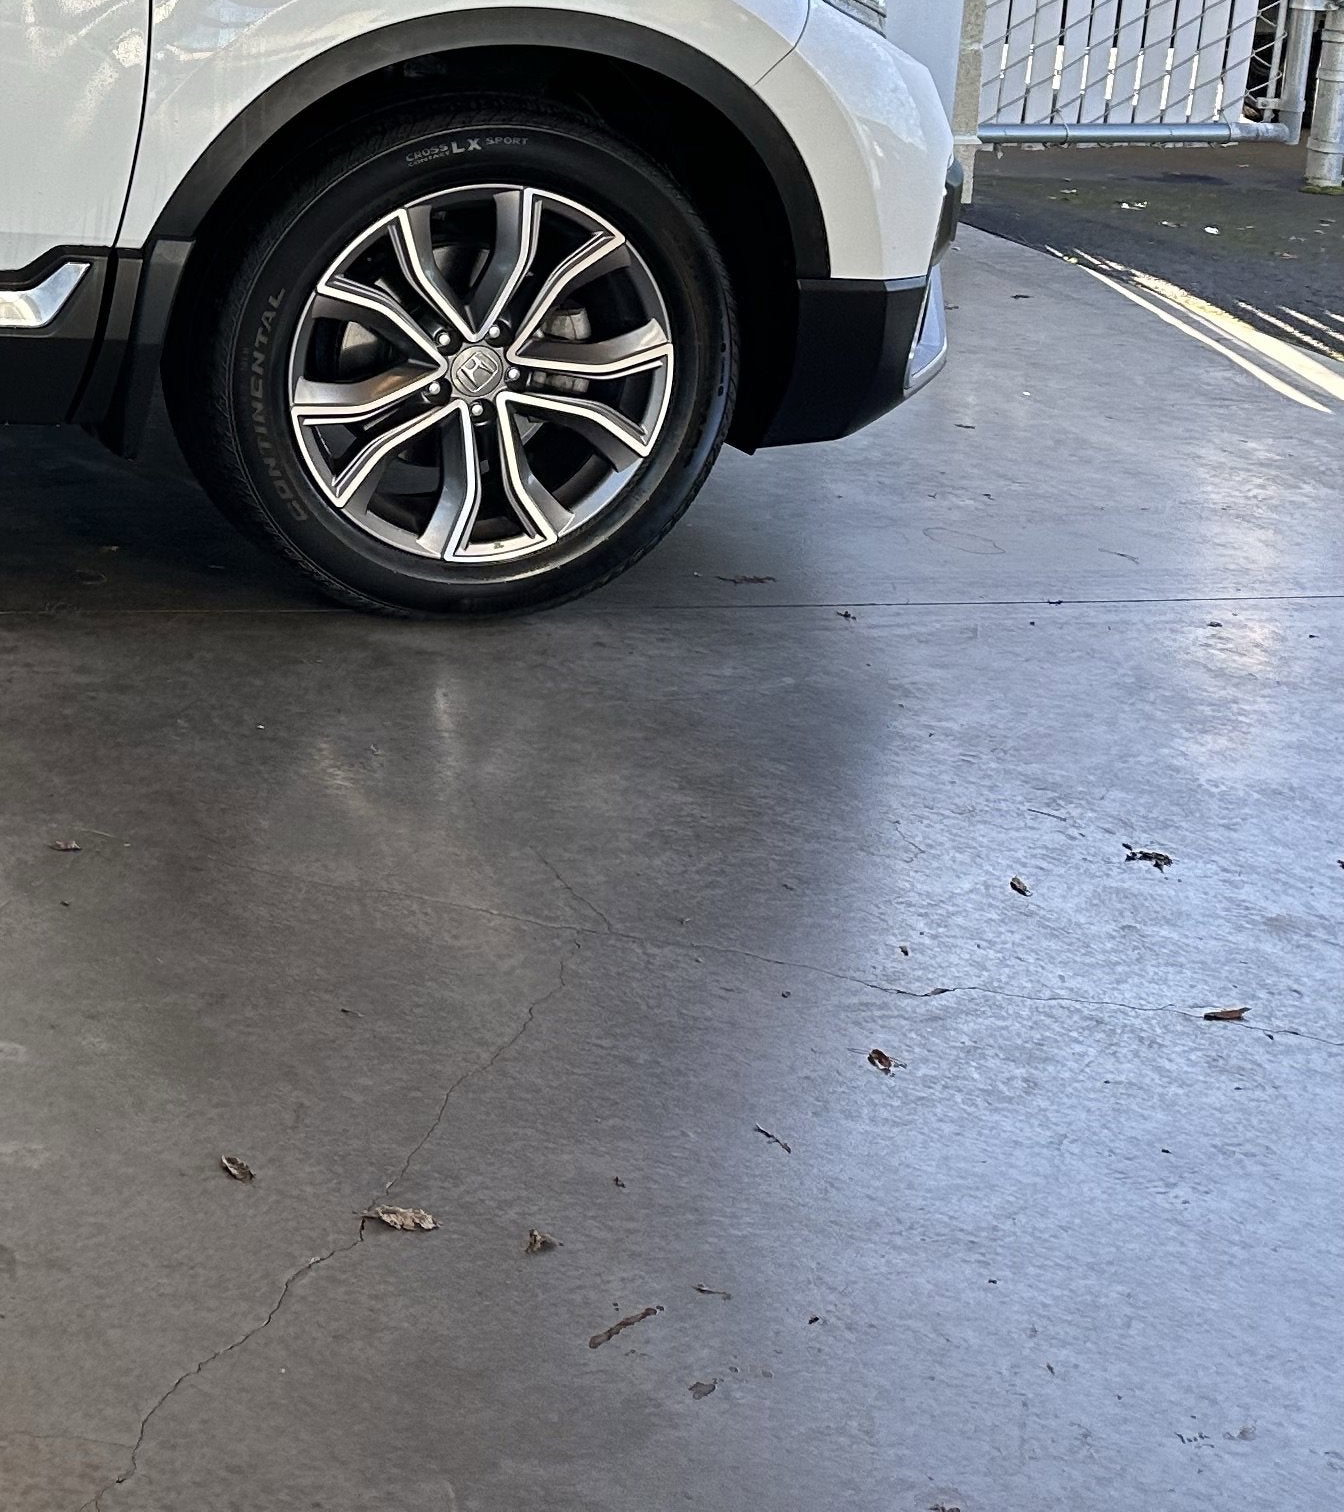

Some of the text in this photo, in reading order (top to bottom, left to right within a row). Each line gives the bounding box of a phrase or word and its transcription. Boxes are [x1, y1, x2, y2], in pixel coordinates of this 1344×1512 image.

[405, 136, 529, 162] CROSS LX SPORT
[250, 287, 309, 521] CONTINENTAL
